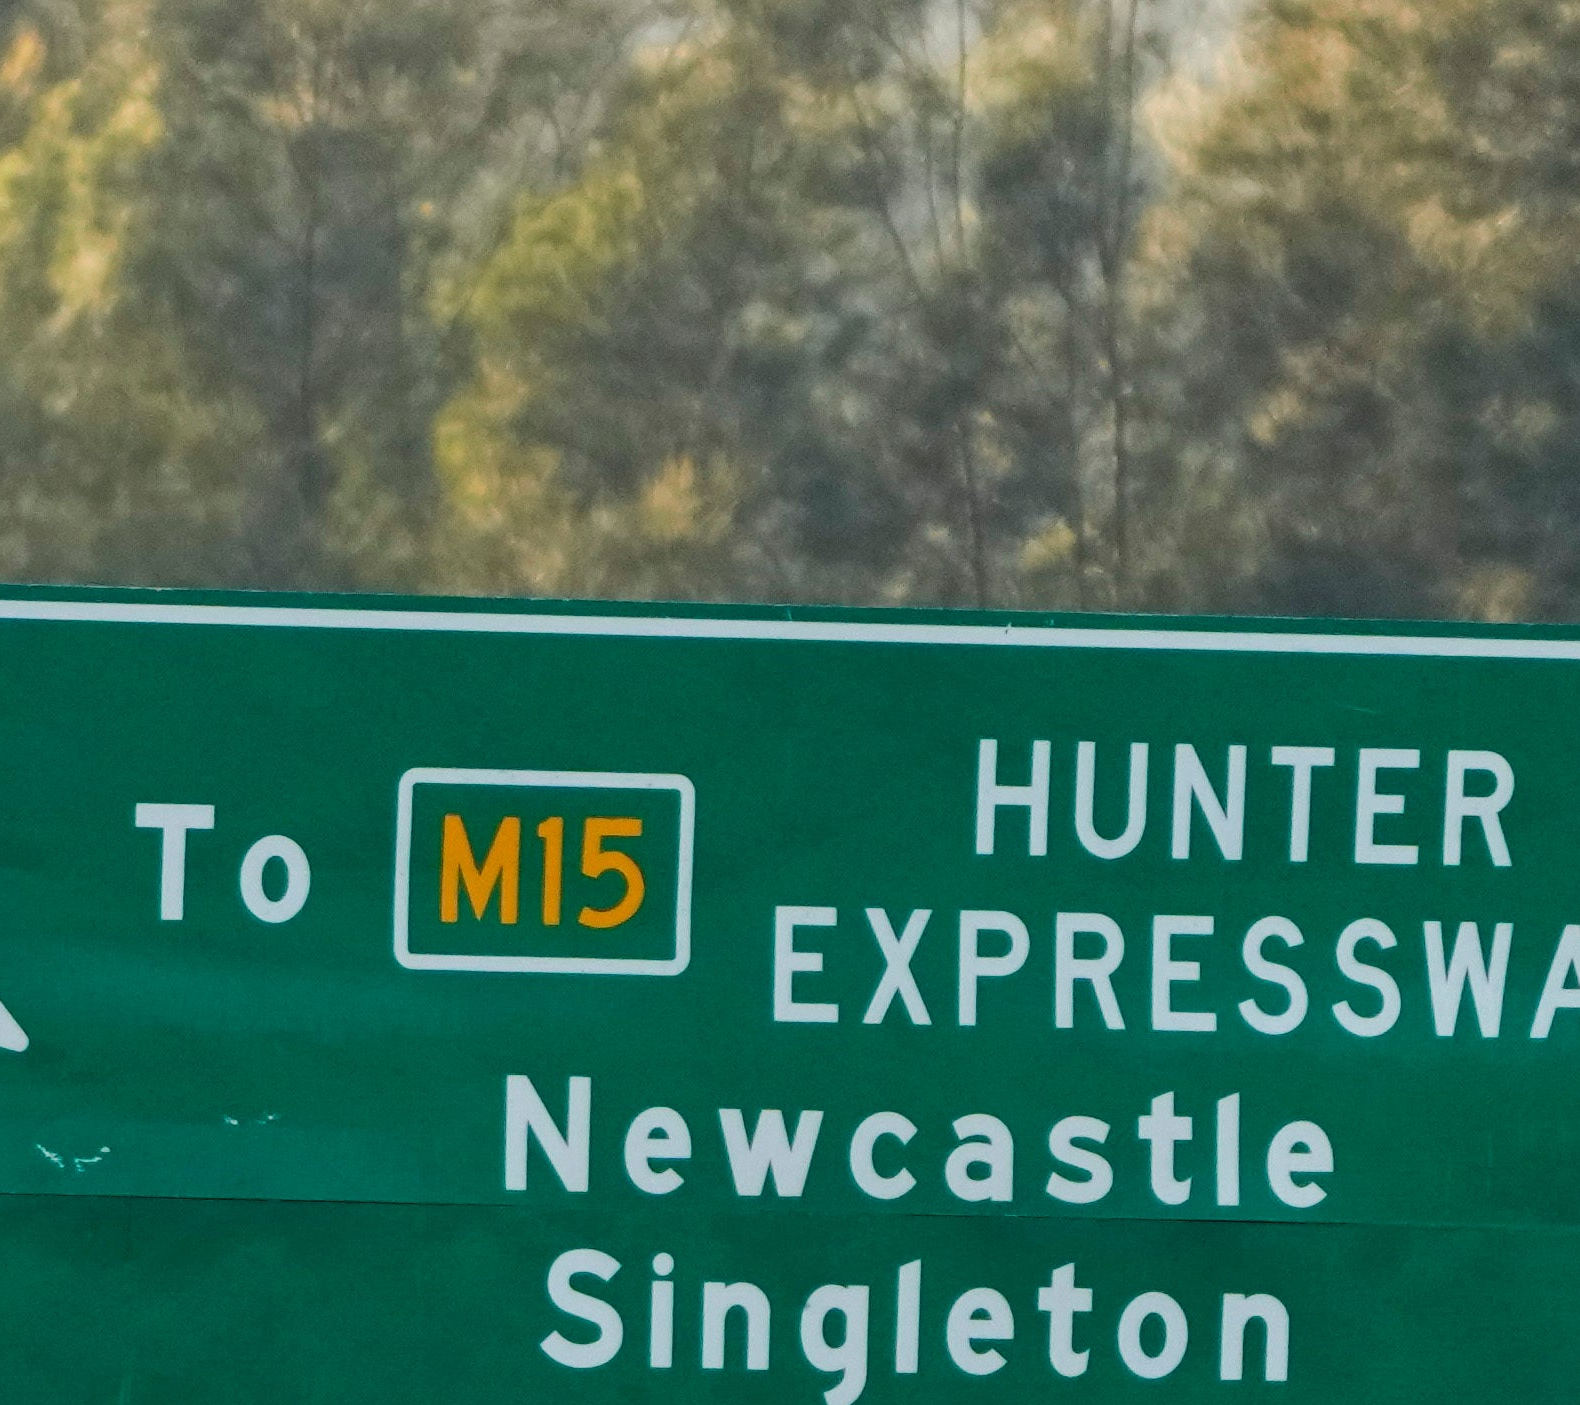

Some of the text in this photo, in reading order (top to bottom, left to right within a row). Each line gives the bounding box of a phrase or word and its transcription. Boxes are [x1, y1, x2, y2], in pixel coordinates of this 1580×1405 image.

[135, 802, 647, 929] To M15
[975, 739, 1515, 868] HUNTER
[504, 1073, 1336, 1208] Newcastle
